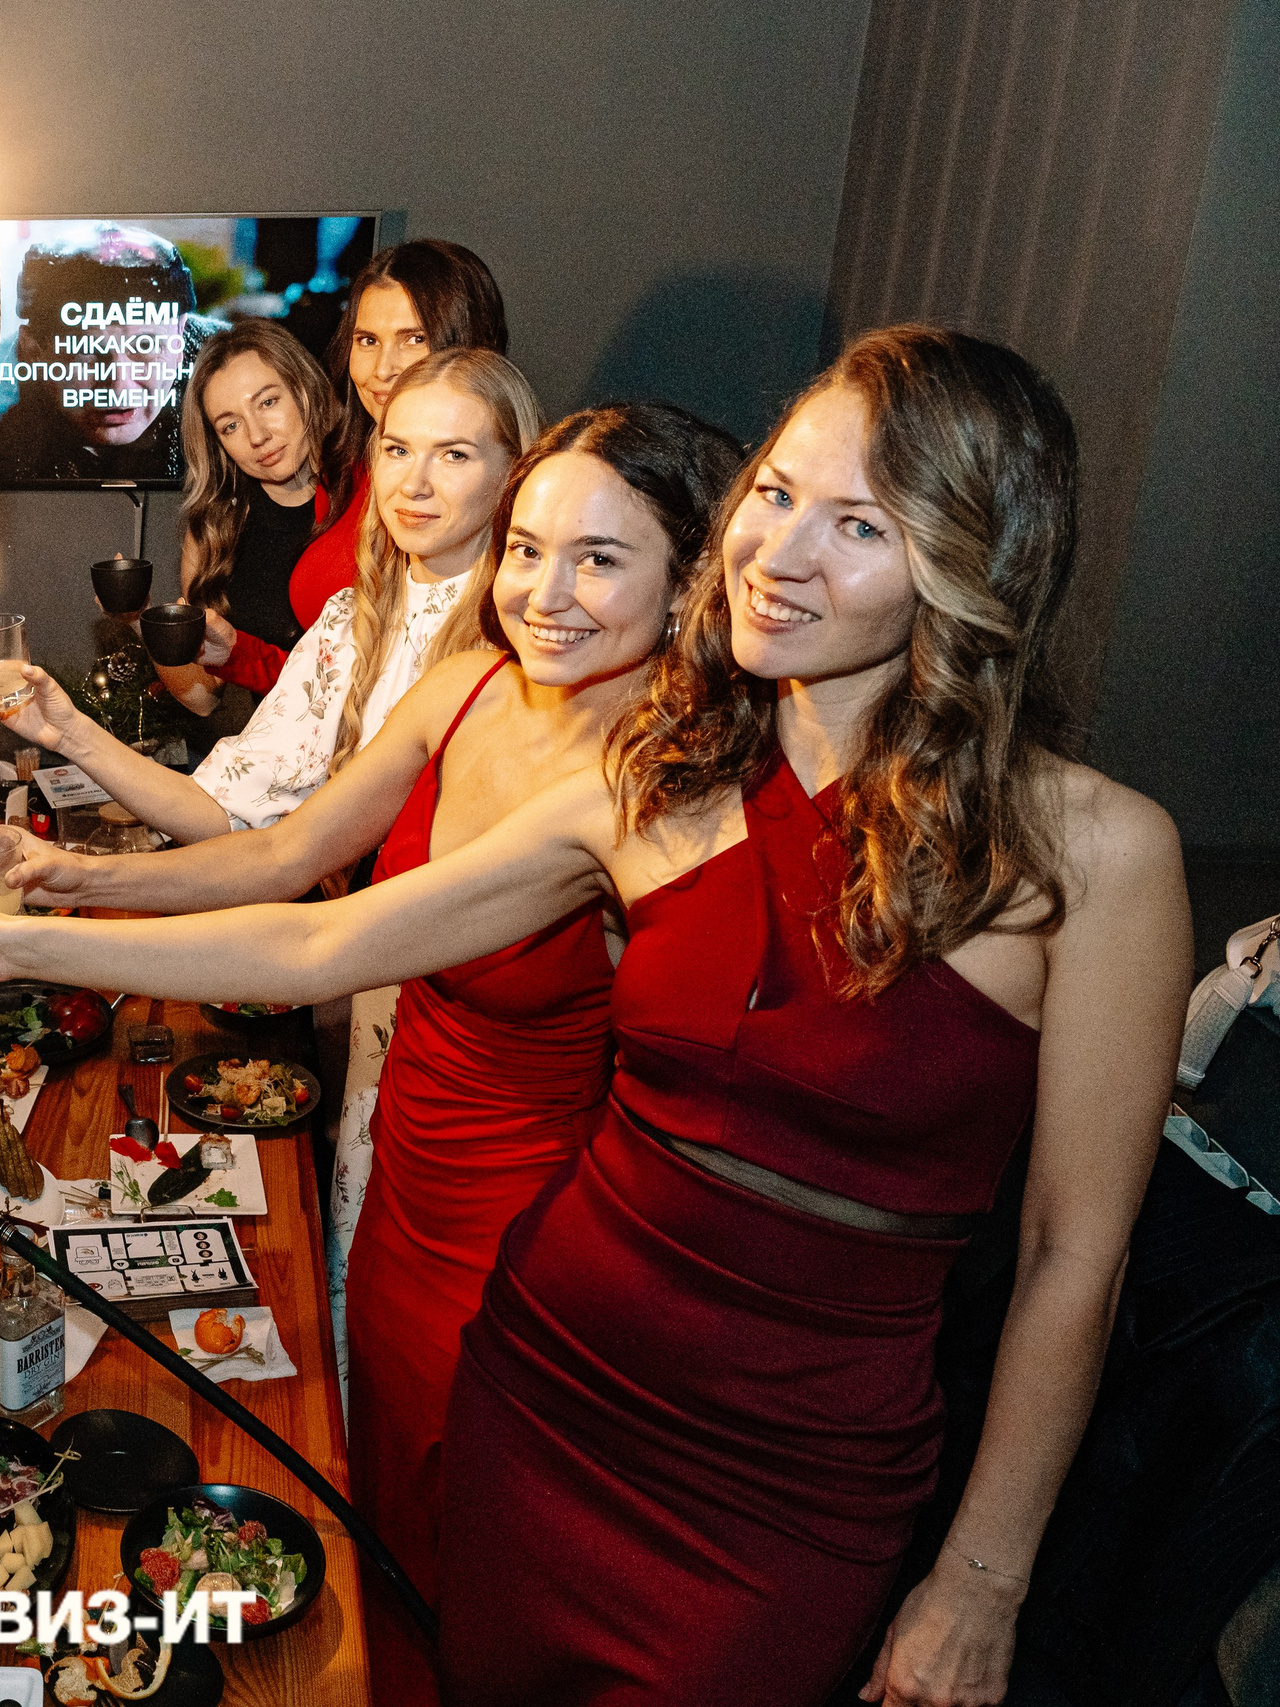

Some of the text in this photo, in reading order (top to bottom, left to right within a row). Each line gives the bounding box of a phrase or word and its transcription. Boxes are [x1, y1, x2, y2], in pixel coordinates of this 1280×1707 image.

[60, 297, 179, 330] СДАЁМ!
[54, 335, 186, 354] НИКАКОГО
[62, 389, 177, 408] ВРЕМЕНИ
[16, 1334, 65, 1374] BARRISTER
[24, 1352, 60, 1379] DRY GIN
